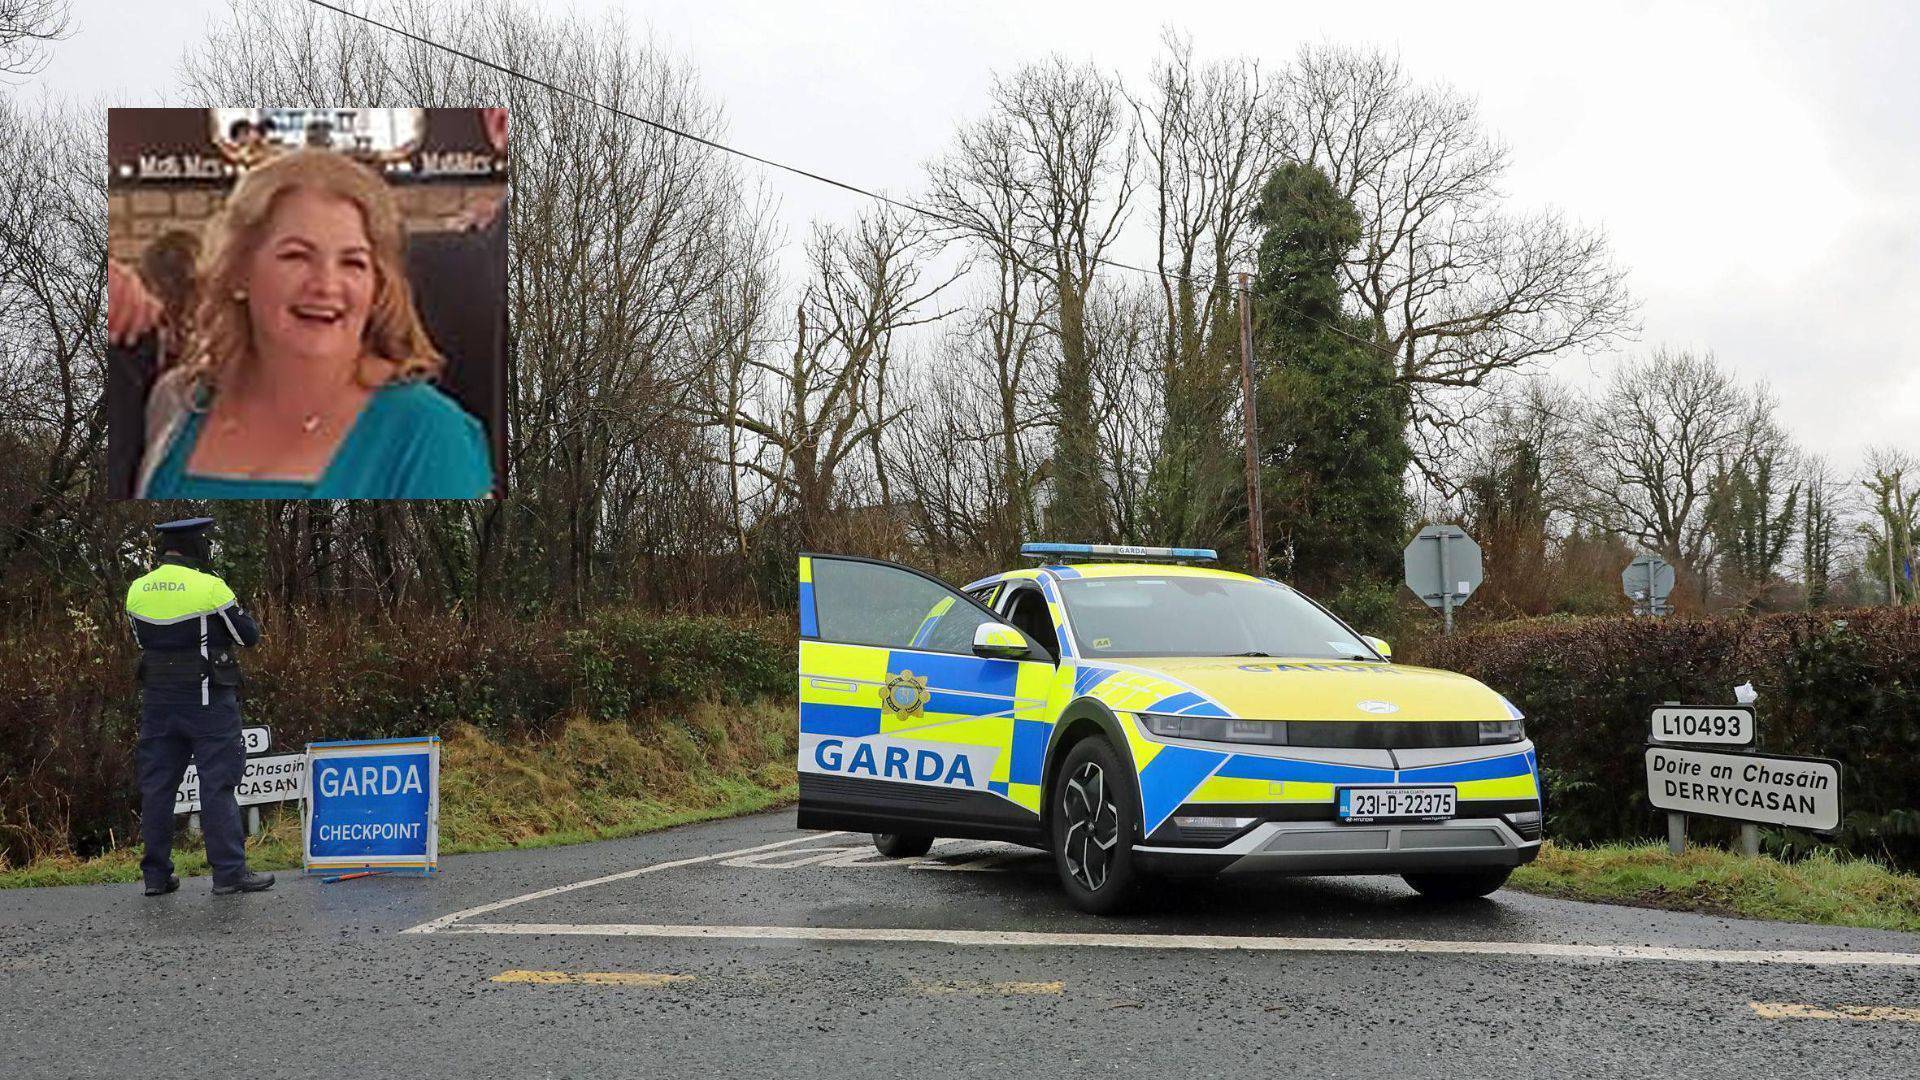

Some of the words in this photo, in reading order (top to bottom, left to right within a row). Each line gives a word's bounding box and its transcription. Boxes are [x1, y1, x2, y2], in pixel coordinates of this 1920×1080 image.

[1119, 547, 1146, 555] GARDA
[142, 582, 186, 592] GARDA
[1663, 715, 1741, 736] L10493
[814, 739, 975, 787] GARDA
[1653, 755, 1701, 777] Doire
[1711, 765, 1733, 780] an
[1743, 764, 1829, 790] Chasáin
[319, 764, 422, 798] GARDA
[1356, 794, 1452, 815] 231-D-22375
[1665, 779, 1816, 815] DERRYCASAN
[319, 823, 421, 841] CHECKPOINT
